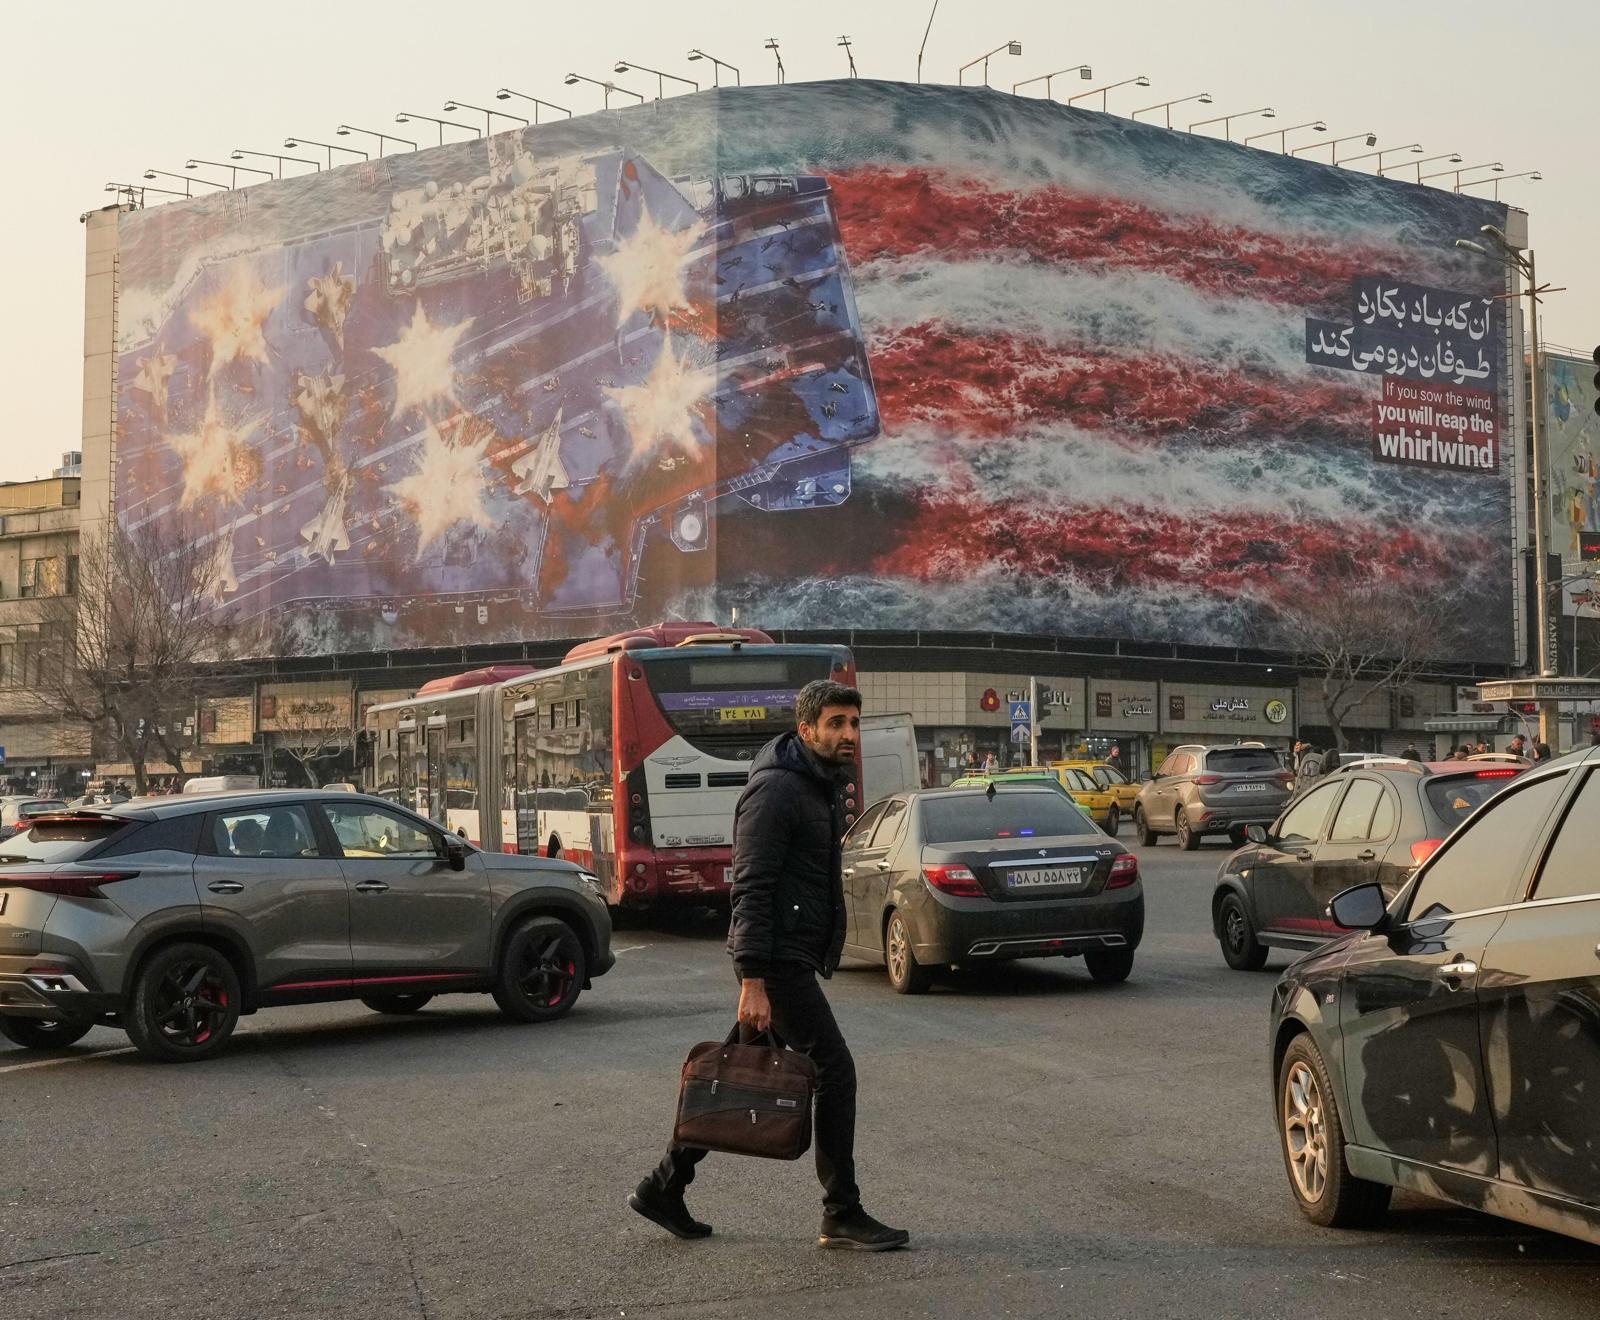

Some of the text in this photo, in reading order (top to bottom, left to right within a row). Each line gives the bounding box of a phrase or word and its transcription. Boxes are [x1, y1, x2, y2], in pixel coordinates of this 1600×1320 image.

[1358, 284, 1493, 340] آن که باد بکارد
[1419, 340, 1491, 385] طوفان
[1386, 382, 1493, 413] If you sow the wind,
[1377, 404, 1493, 434] you will reap the
[1378, 427, 1494, 469] whirlwind
[1212, 698, 1249, 711] کفش ملی
[1538, 685, 1569, 695] POLICE
[1124, 704, 1152, 717] ساعتی
